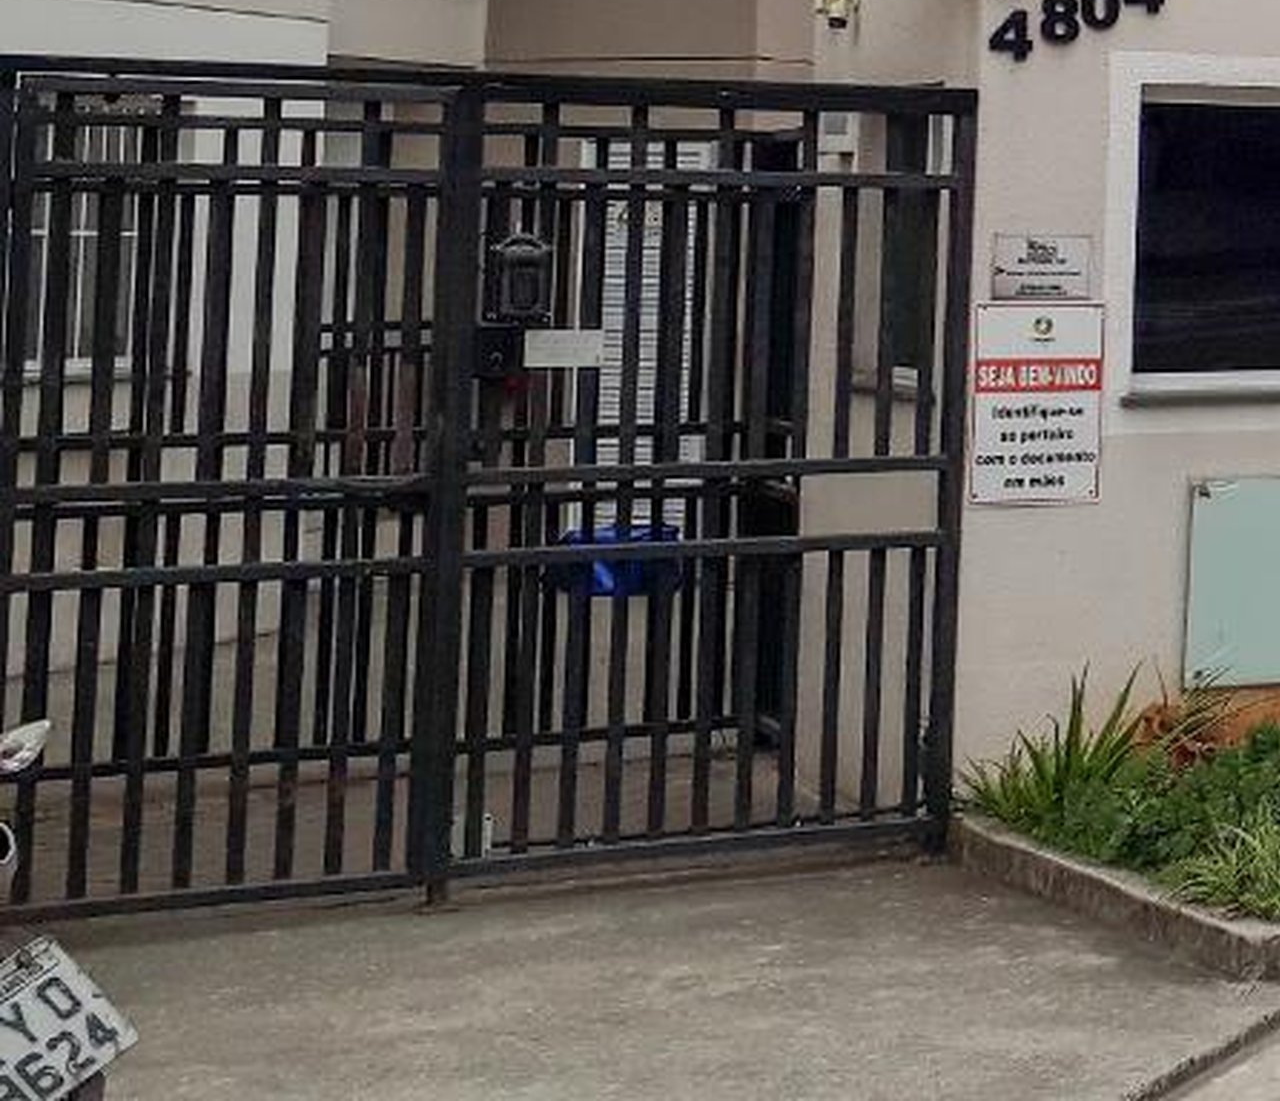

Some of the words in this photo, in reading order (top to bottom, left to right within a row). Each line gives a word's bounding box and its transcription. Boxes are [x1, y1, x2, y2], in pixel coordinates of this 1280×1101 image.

[978, 365, 1016, 387] SEJA
[1019, 363, 1097, 386] BEM-VINDO
[1000, 431, 1016, 443] ao
[976, 455, 1005, 466] com
[1009, 455, 1017, 466] o
[1021, 452, 1096, 466] documento
[1004, 477, 1025, 489] em
[0, 976, 82, 1049] YO
